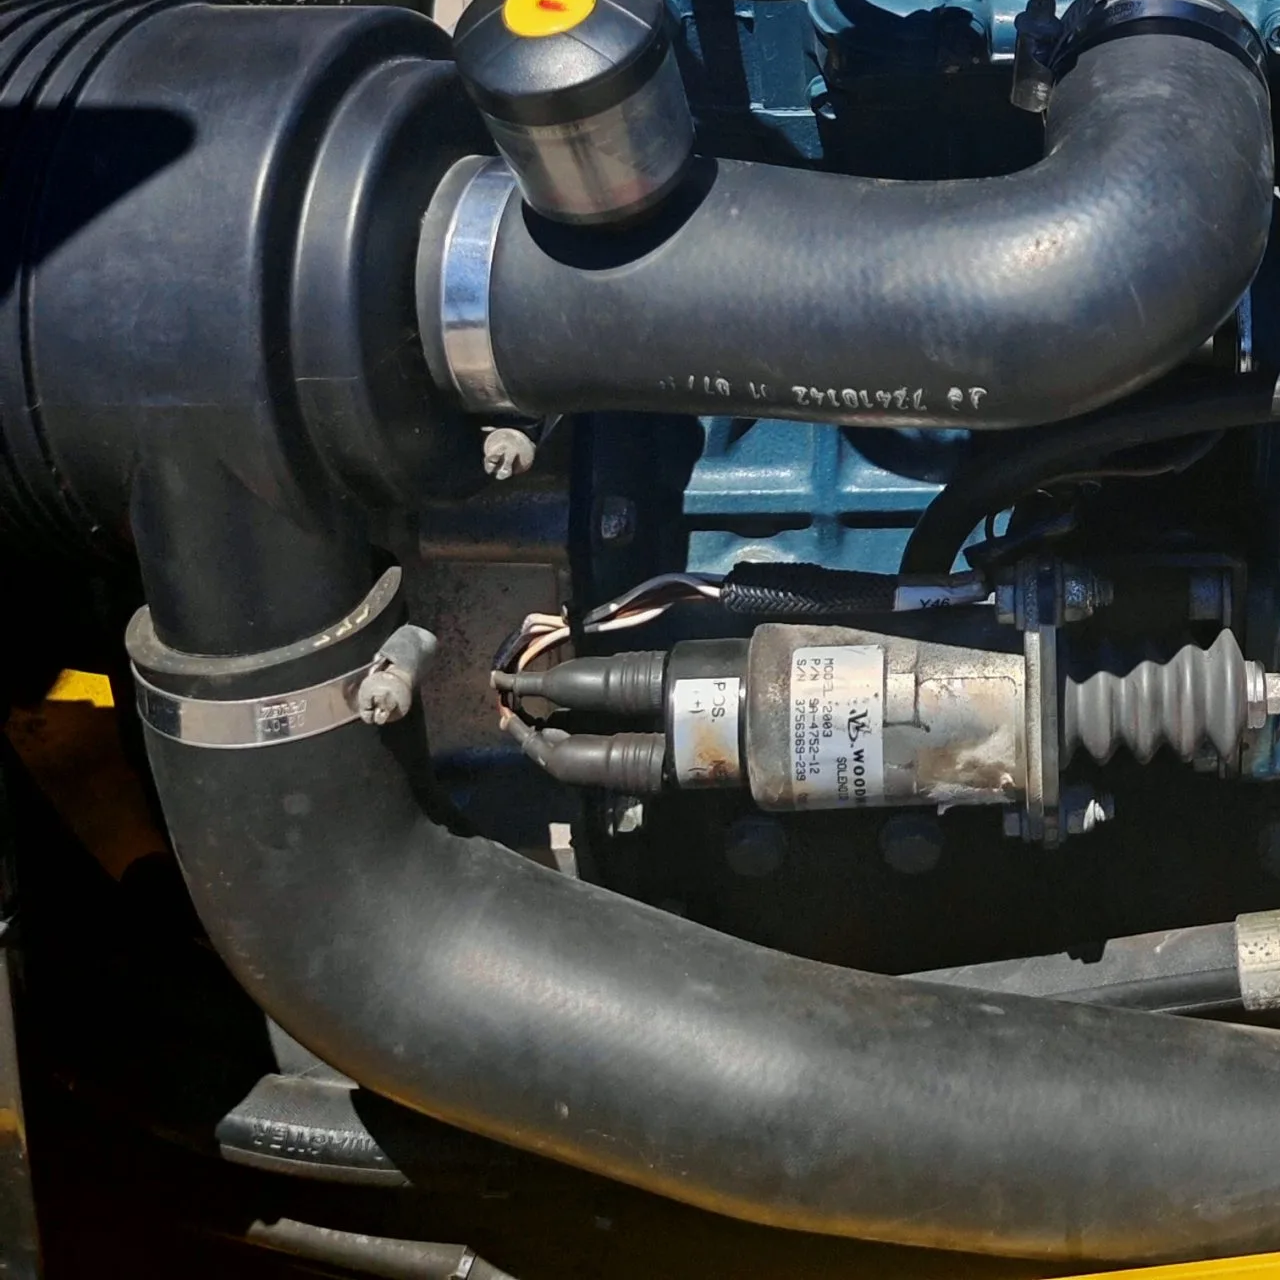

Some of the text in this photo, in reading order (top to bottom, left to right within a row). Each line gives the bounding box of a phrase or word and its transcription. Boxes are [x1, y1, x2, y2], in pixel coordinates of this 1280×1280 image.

[808, 657, 821, 775] P/N SA-4752-12
[822, 705, 833, 738] 2003
